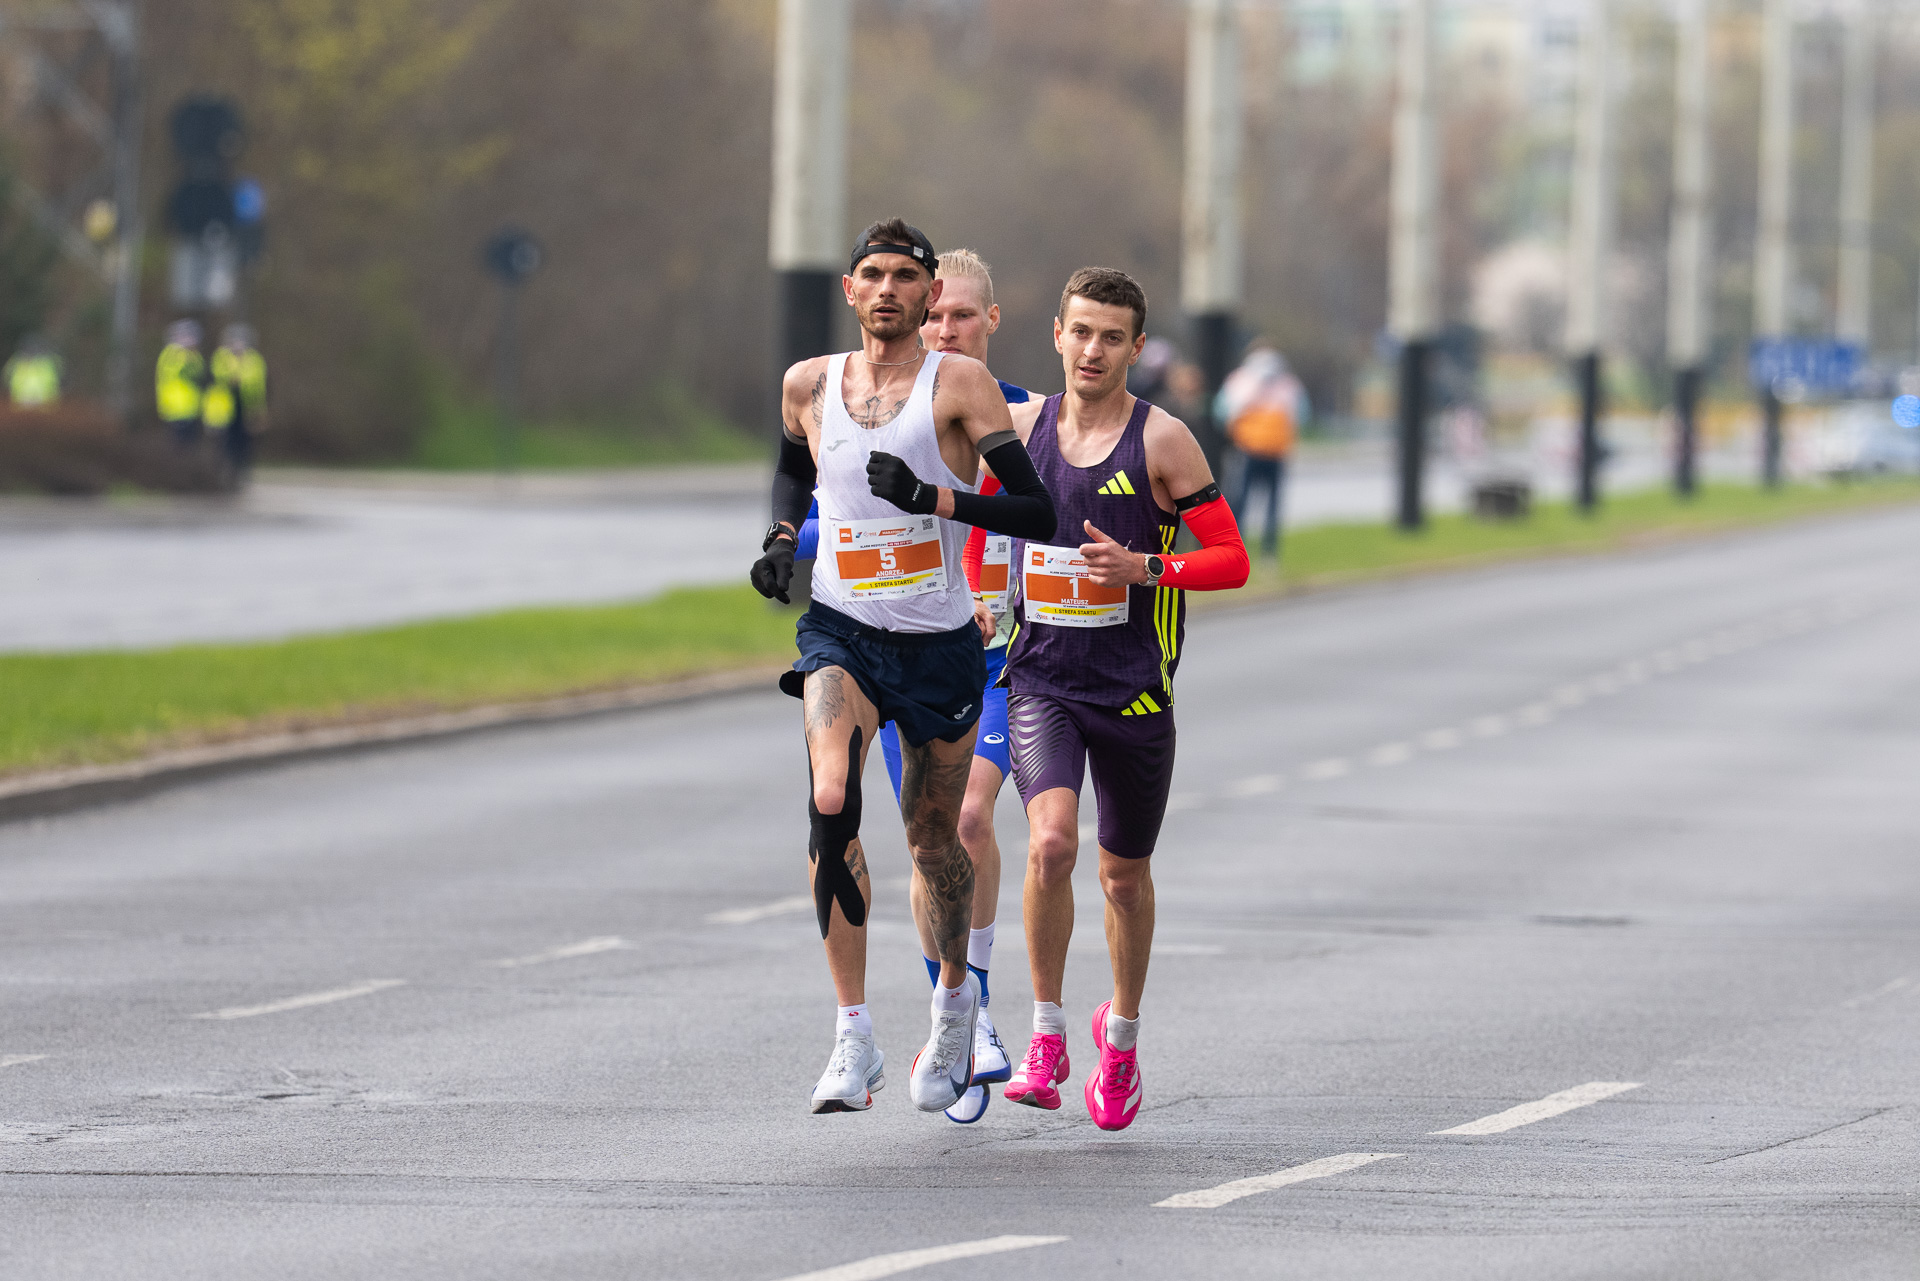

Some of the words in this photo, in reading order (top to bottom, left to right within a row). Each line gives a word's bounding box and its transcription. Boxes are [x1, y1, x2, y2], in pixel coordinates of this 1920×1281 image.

[879, 548, 897, 570] 5
[876, 569, 904, 577] ANDRZEJ
[894, 579, 913, 587] STARTU
[1069, 577, 1079, 598] 1
